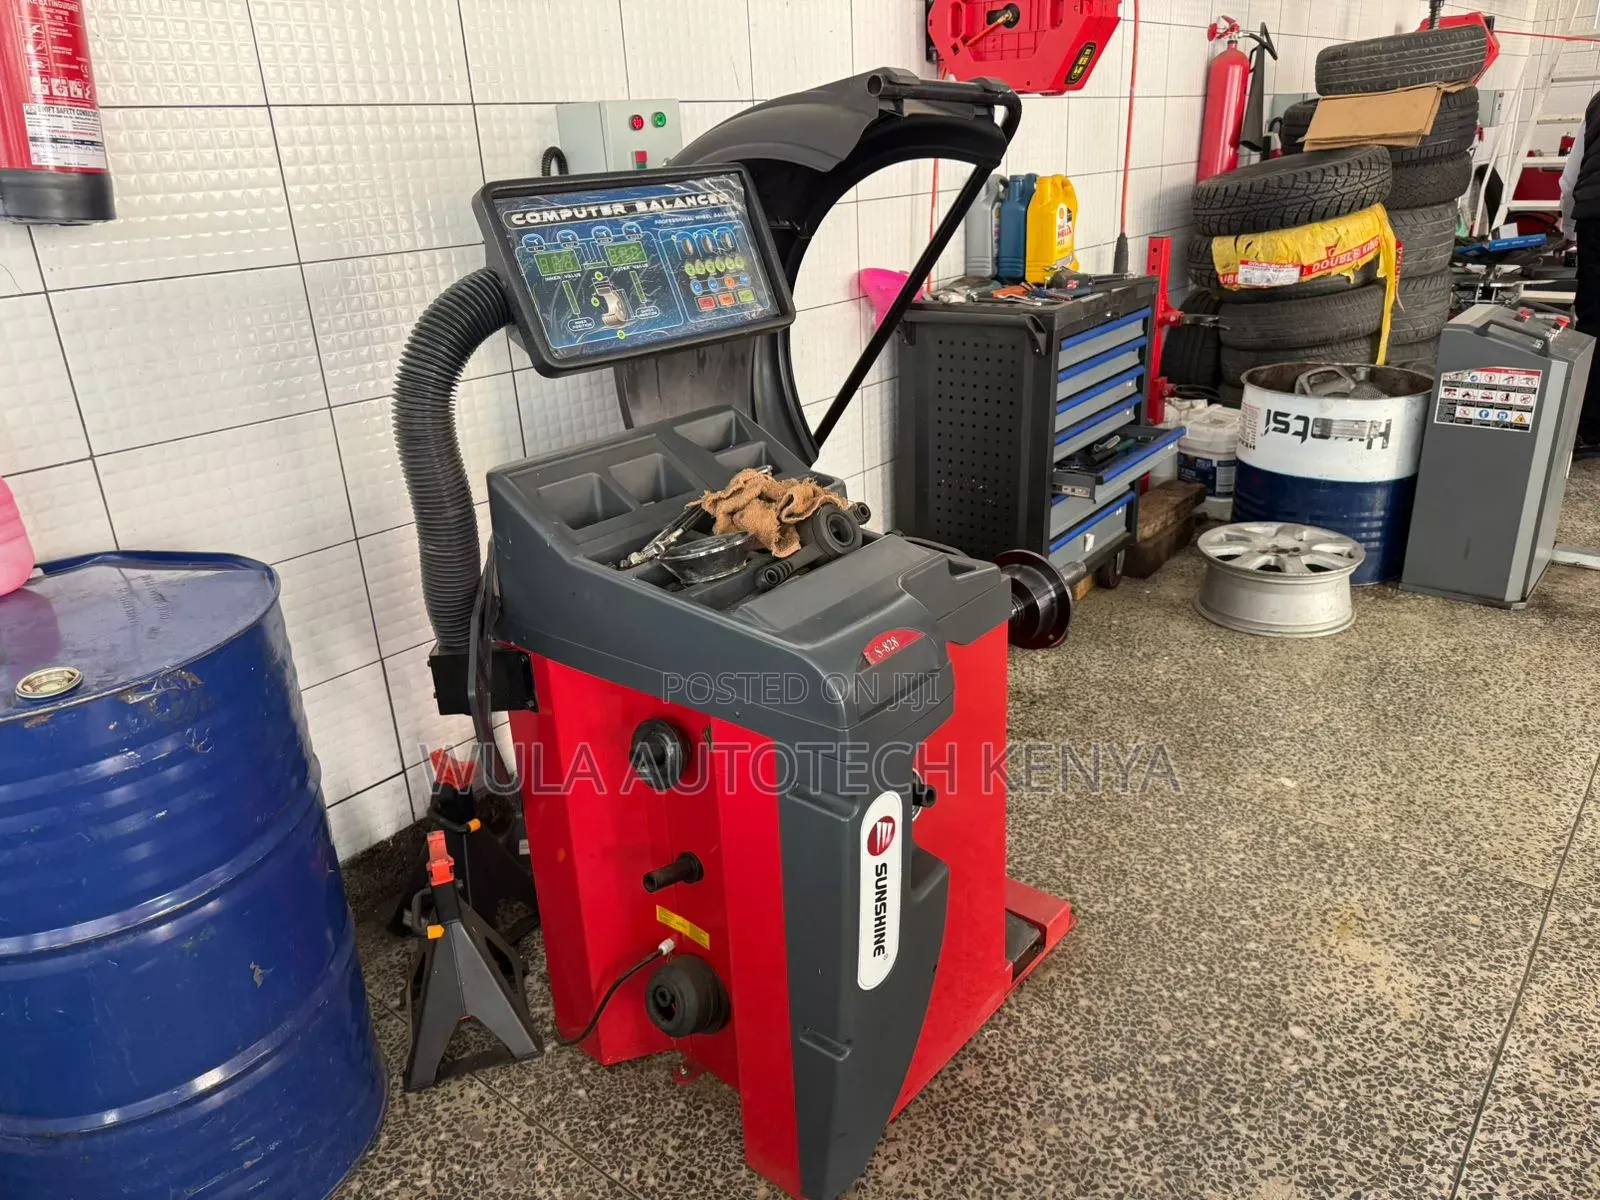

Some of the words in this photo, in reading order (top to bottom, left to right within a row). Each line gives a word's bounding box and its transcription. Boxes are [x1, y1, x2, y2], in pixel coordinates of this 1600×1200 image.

[511, 202, 628, 225] COMPUTER
[874, 635, 900, 658] S-828
[873, 862, 888, 958] SUNSHINE
